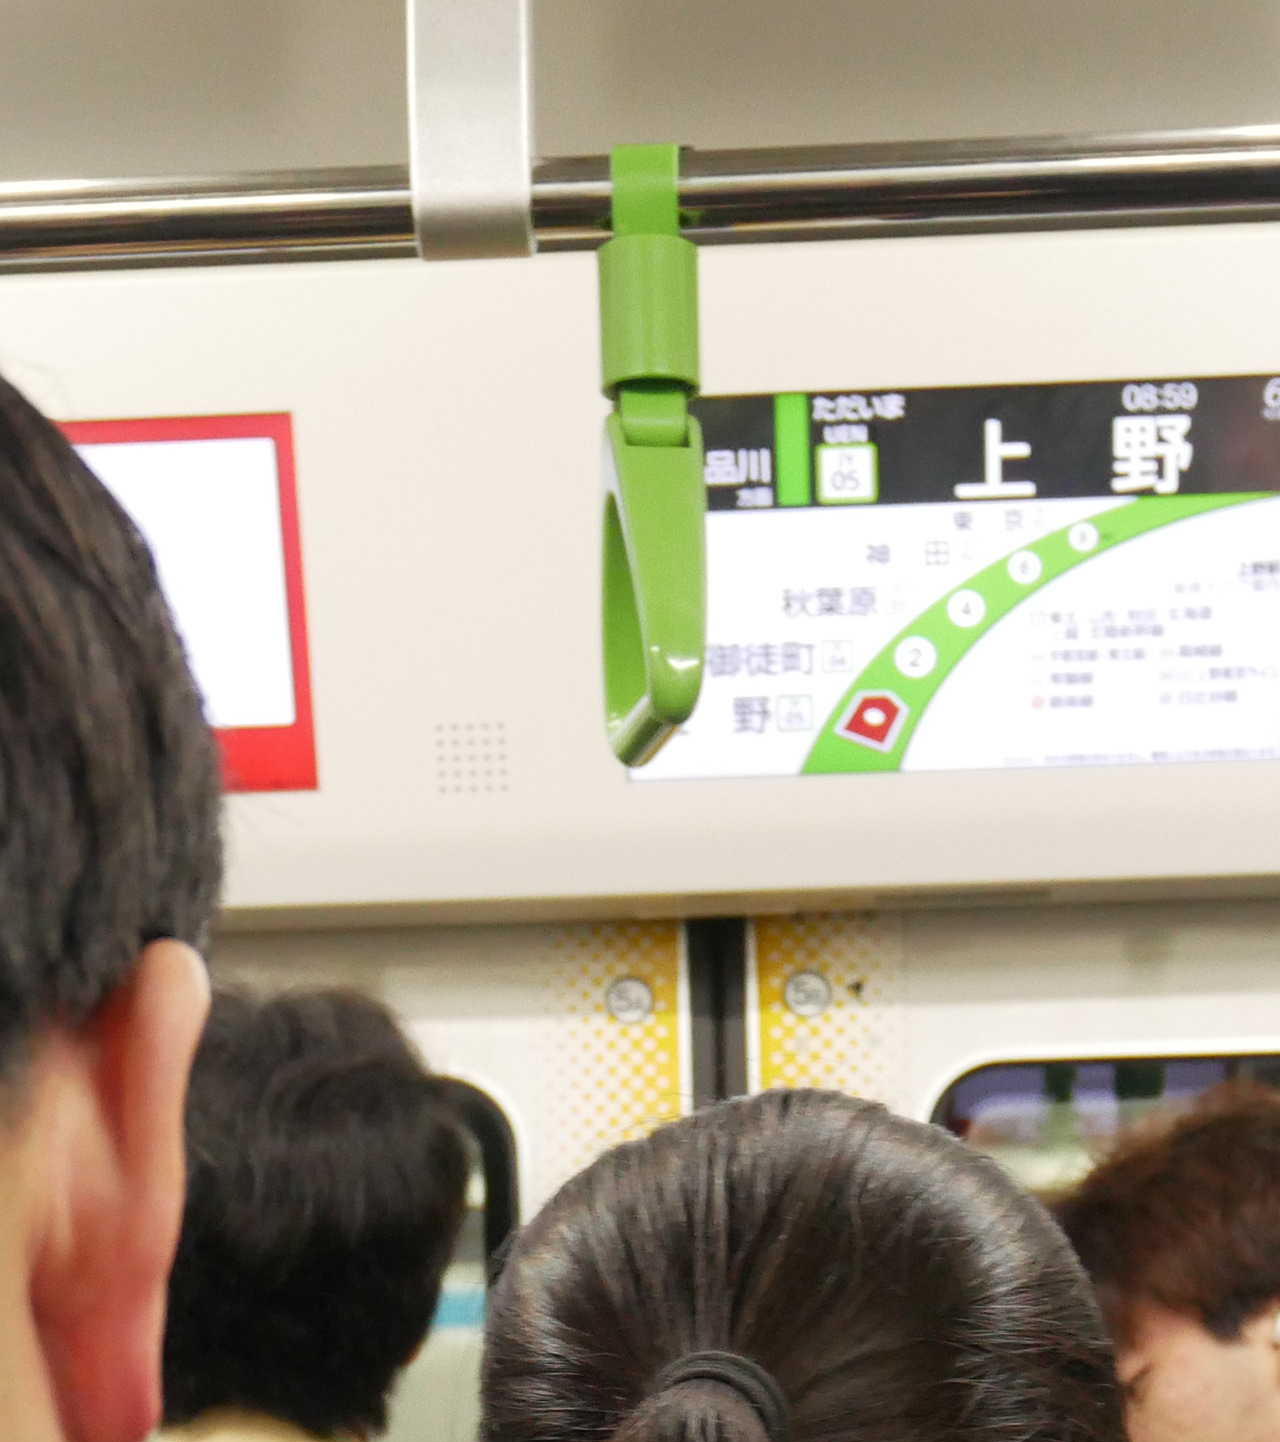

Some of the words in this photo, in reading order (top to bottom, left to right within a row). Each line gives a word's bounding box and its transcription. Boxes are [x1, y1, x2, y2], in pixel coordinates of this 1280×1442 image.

[1122, 382, 1198, 411] 08:59
[705, 448, 771, 485] 品川
[953, 413, 1194, 499] 上野
[831, 470, 860, 492] 05
[782, 586, 877, 618] 秋葉原
[960, 601, 972, 616] 4
[909, 648, 921, 669] 2
